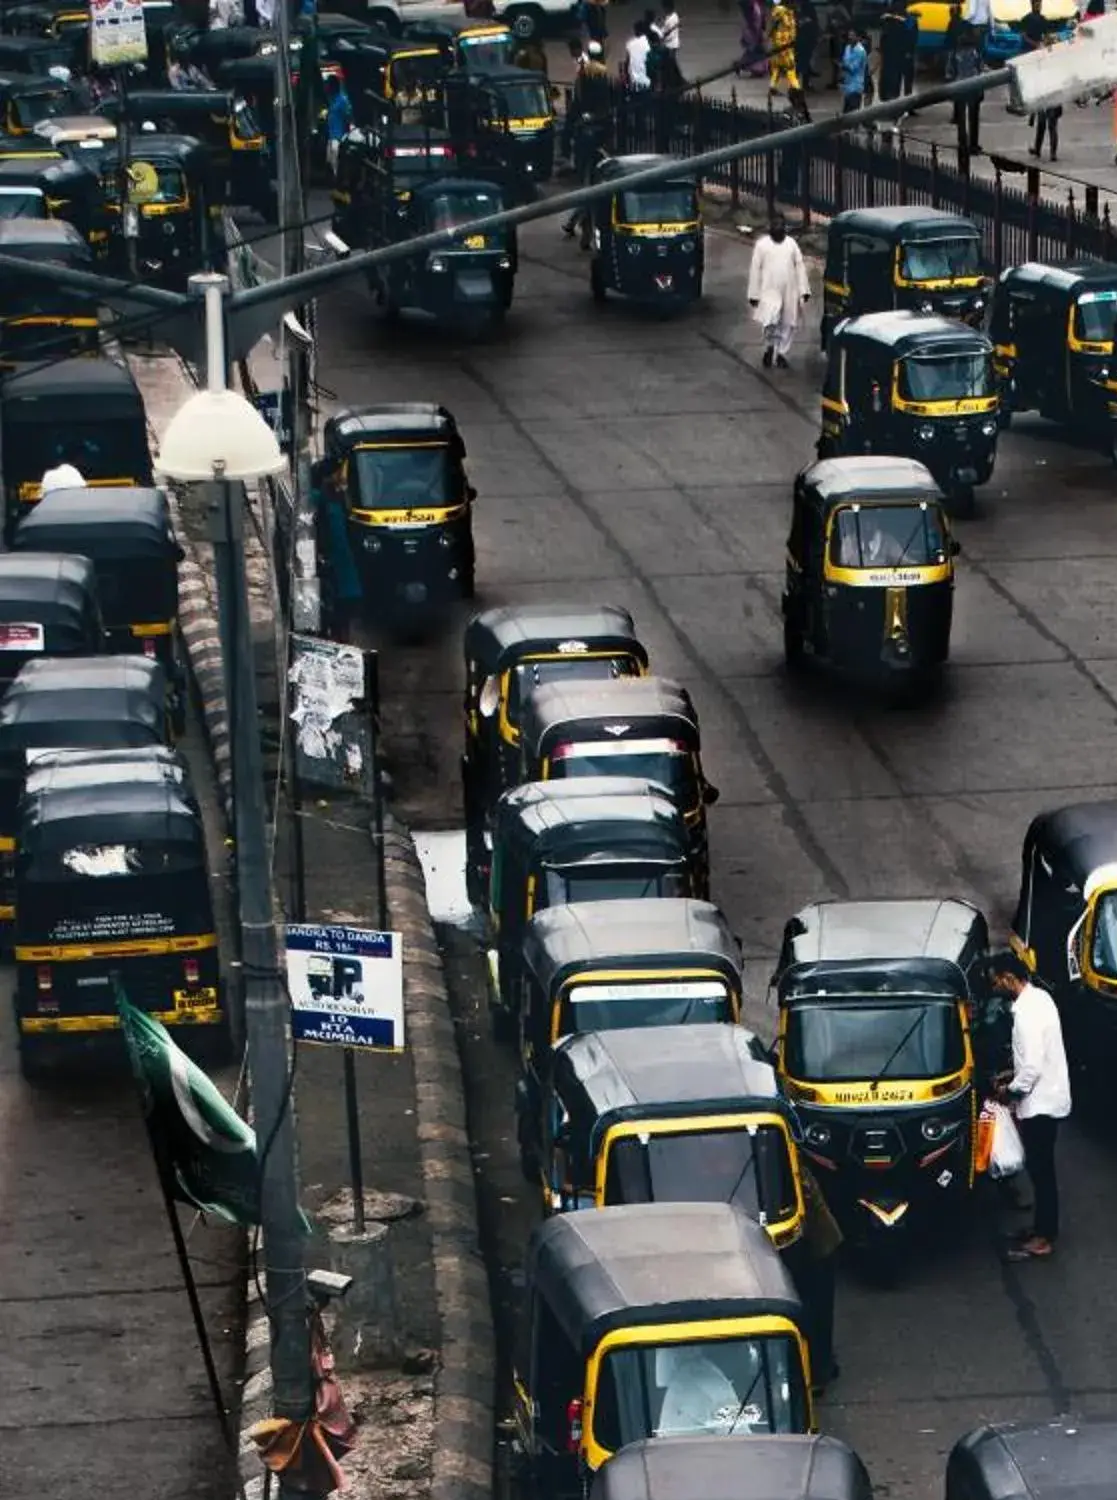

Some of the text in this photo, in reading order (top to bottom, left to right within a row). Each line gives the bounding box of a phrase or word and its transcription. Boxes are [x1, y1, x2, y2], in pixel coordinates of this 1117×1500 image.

[330, 930, 346, 941] TO
[347, 932, 386, 944] DANDA
[303, 1029, 374, 1045] MUMBAI
